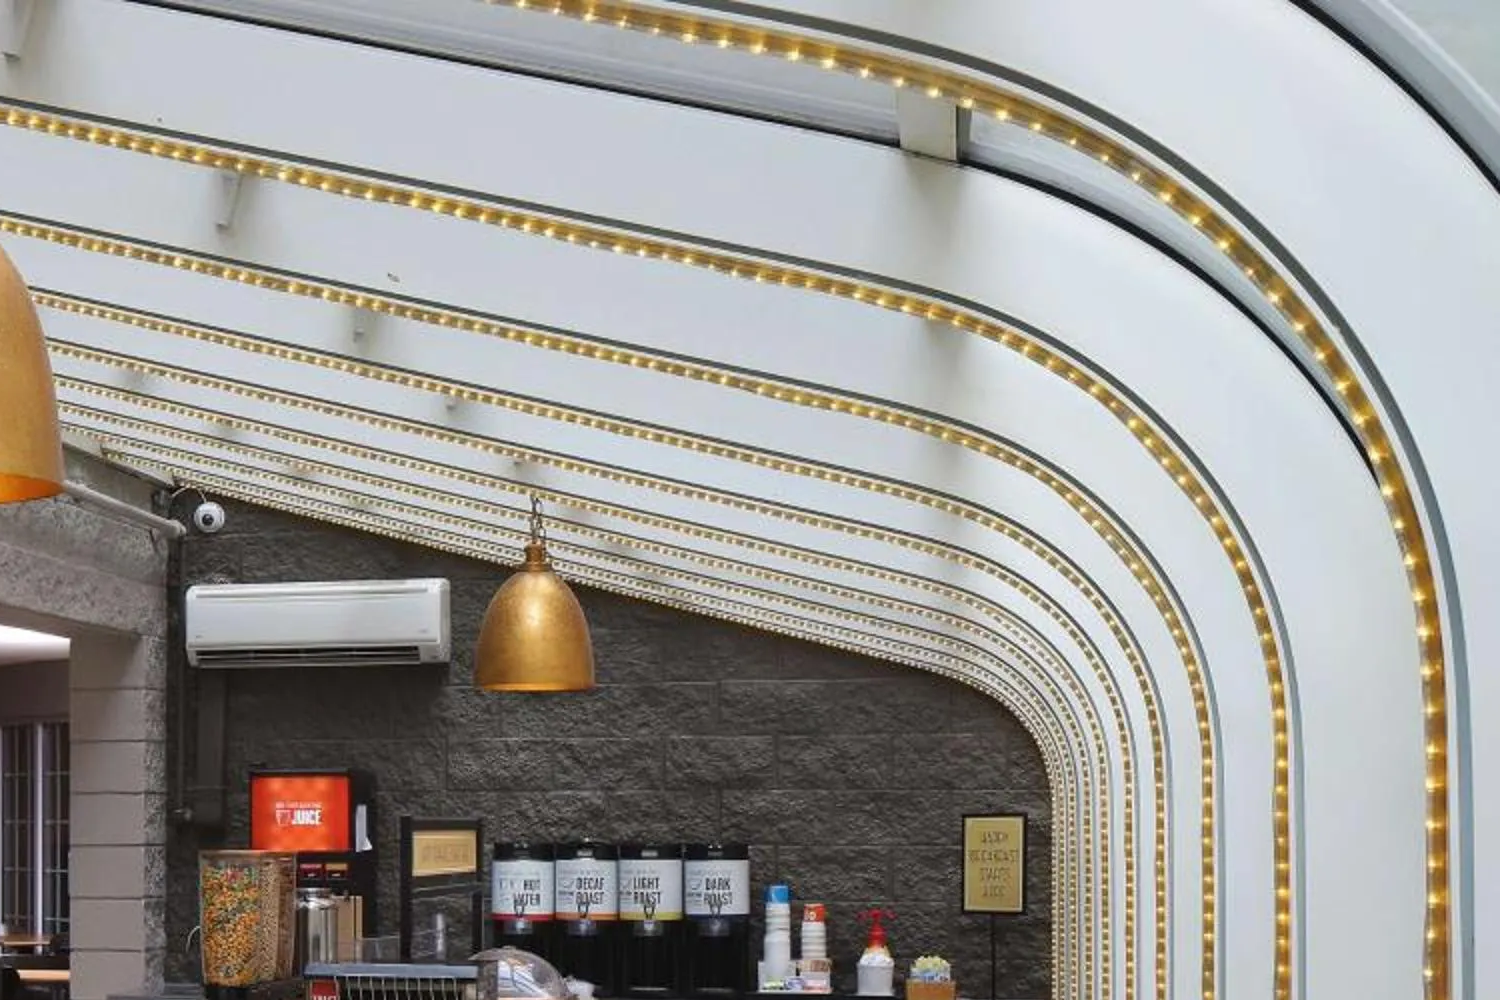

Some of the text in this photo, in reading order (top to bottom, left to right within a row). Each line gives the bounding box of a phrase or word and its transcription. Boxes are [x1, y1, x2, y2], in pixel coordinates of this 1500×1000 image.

[291, 809, 322, 825] JUICE
[576, 877, 605, 890] DECAF
[633, 877, 660, 890] LIGHT
[705, 877, 731, 891] DARK
